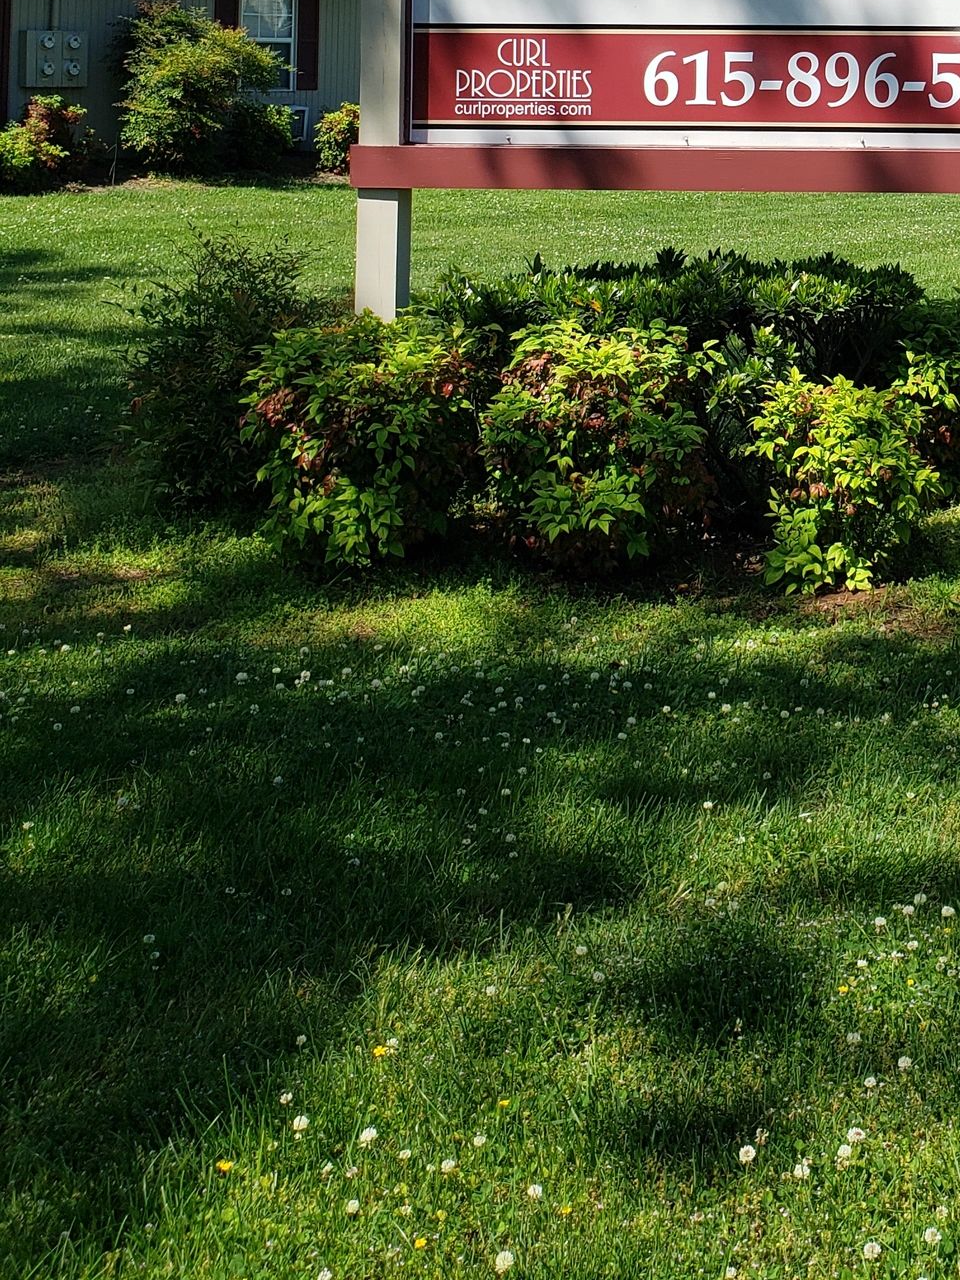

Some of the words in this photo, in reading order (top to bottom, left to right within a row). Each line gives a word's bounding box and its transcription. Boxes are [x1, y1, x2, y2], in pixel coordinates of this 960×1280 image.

[497, 38, 551, 67] CURL
[455, 69, 593, 98] PROPERTIES
[454, 101, 592, 118] curlproperties.com
